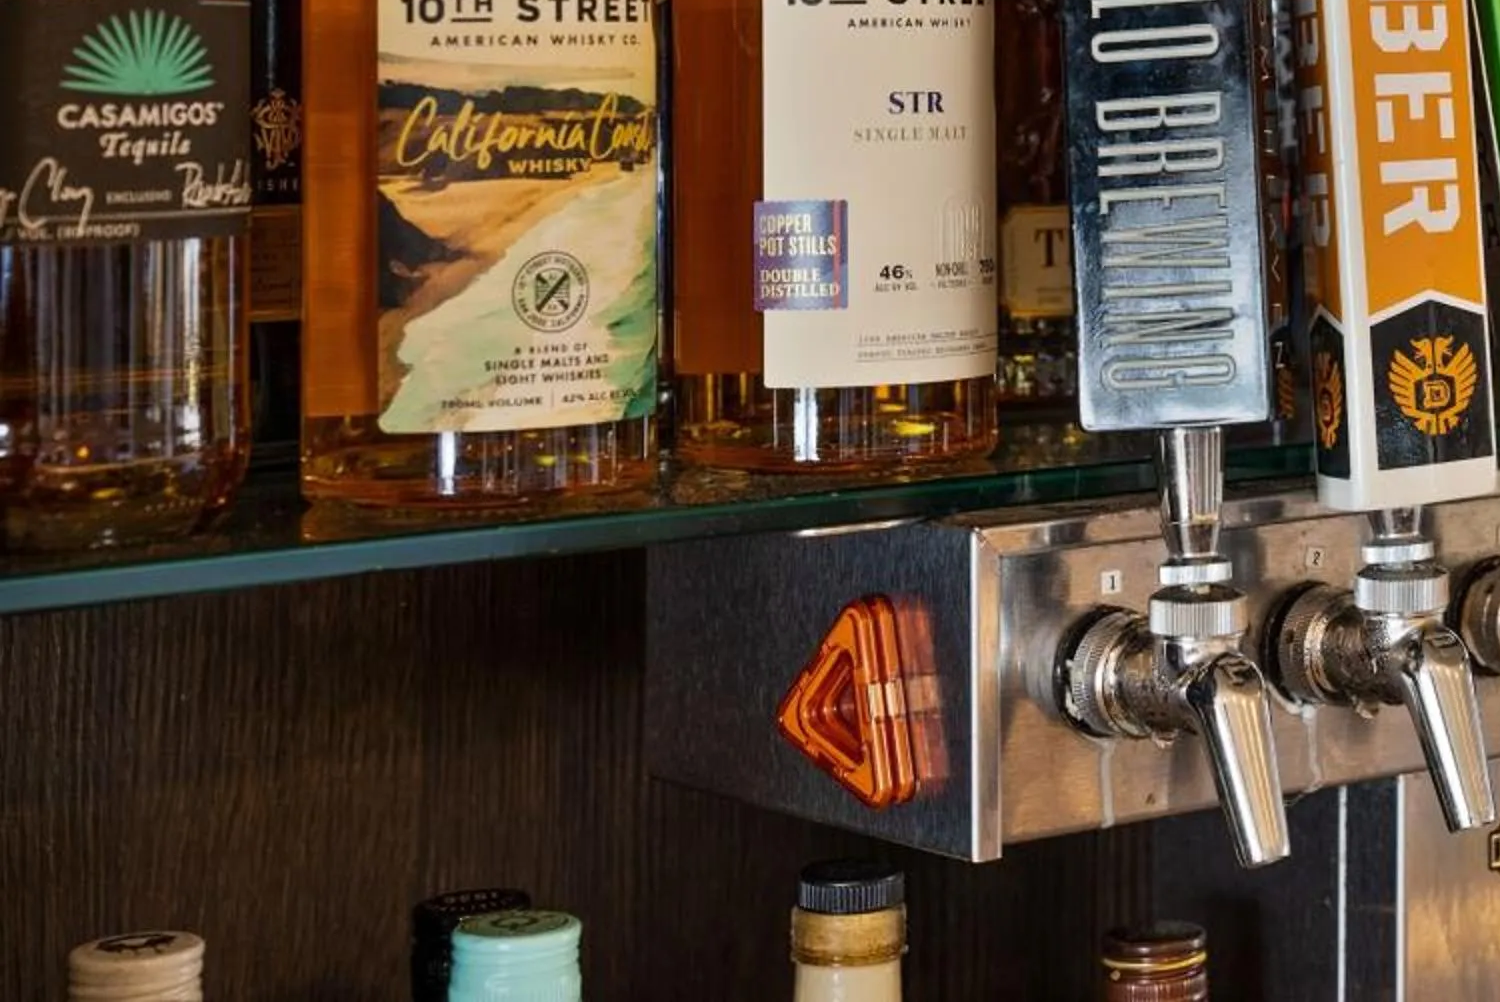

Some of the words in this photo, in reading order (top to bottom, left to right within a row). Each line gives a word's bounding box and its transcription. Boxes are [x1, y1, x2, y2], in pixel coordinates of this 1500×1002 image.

[847, 17, 924, 29] AMERICAN
[430, 34, 538, 47] AMERICAN
[551, 34, 615, 46] WHISKY
[888, 90, 945, 116] STR
[57, 102, 219, 130] CASAMIGOS
[396, 96, 586, 170] California
[853, 127, 922, 142] SINGLE
[928, 125, 968, 141] MALT
[99, 131, 191, 166] Tequila
[508, 157, 592, 175] WHISKY
[759, 213, 812, 235] COPPER
[759, 236, 784, 257] POT
[788, 234, 838, 256] STILLS
[1096, 91, 1236, 392] BREWING
[760, 267, 822, 283] DOUBLE
[761, 282, 840, 299] DISTILLED
[484, 360, 535, 373] SINGLE
[541, 357, 581, 368] MALTS
[488, 396, 543, 408] VOLUME
